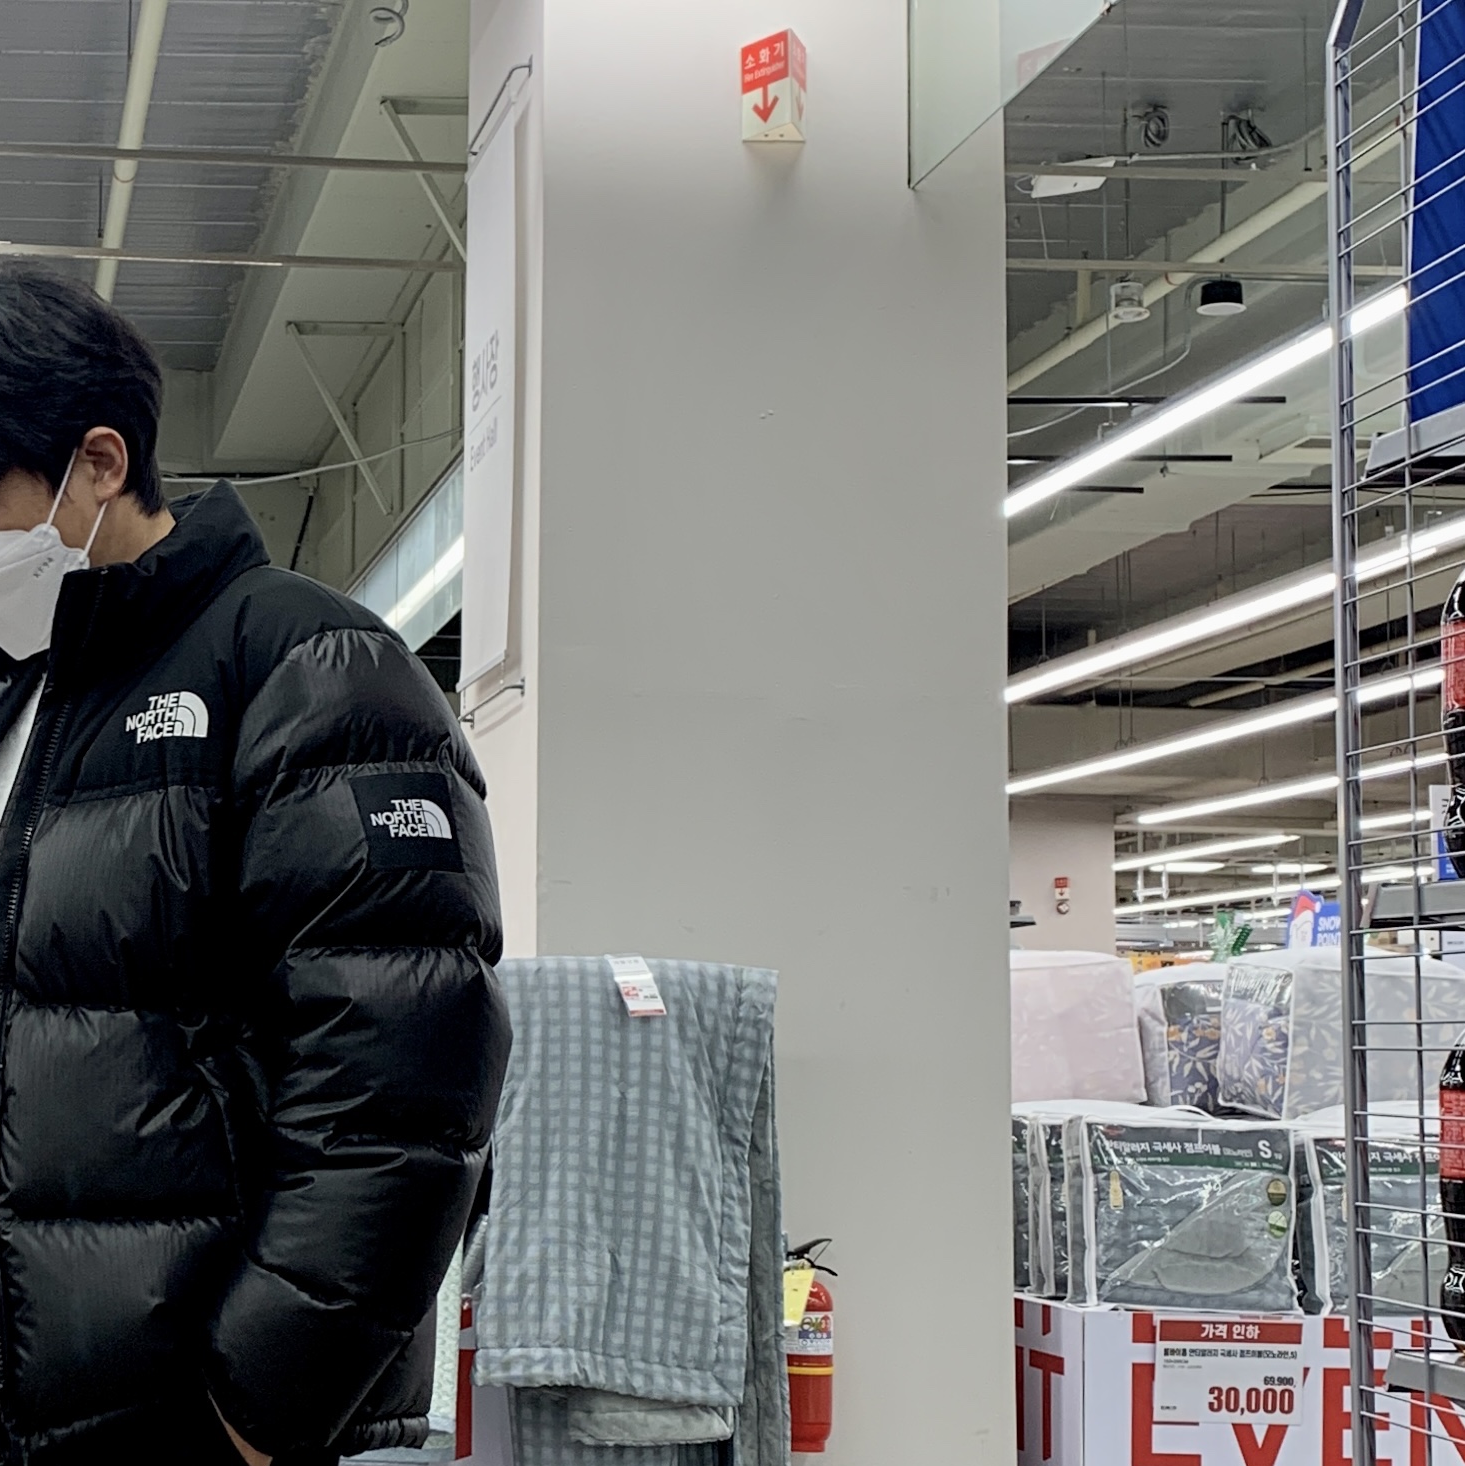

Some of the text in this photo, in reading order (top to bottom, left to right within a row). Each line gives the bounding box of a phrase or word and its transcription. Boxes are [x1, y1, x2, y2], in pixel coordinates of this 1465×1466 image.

[744, 41, 784, 69] 소화기
[471, 329, 499, 412] 행사장
[148, 692, 180, 710] THE
[125, 708, 177, 732] NORTH
[136, 722, 175, 744] FACE
[390, 798, 423, 811] THE
[369, 810, 425, 827] NORTH
[388, 823, 429, 838] FACE
[1257, 1139, 1273, 1159] S
[1200, 1323, 1227, 1339] 가격
[1232, 1324, 1261, 1340] 인하
[1208, 1386, 1295, 1416] 30,000
